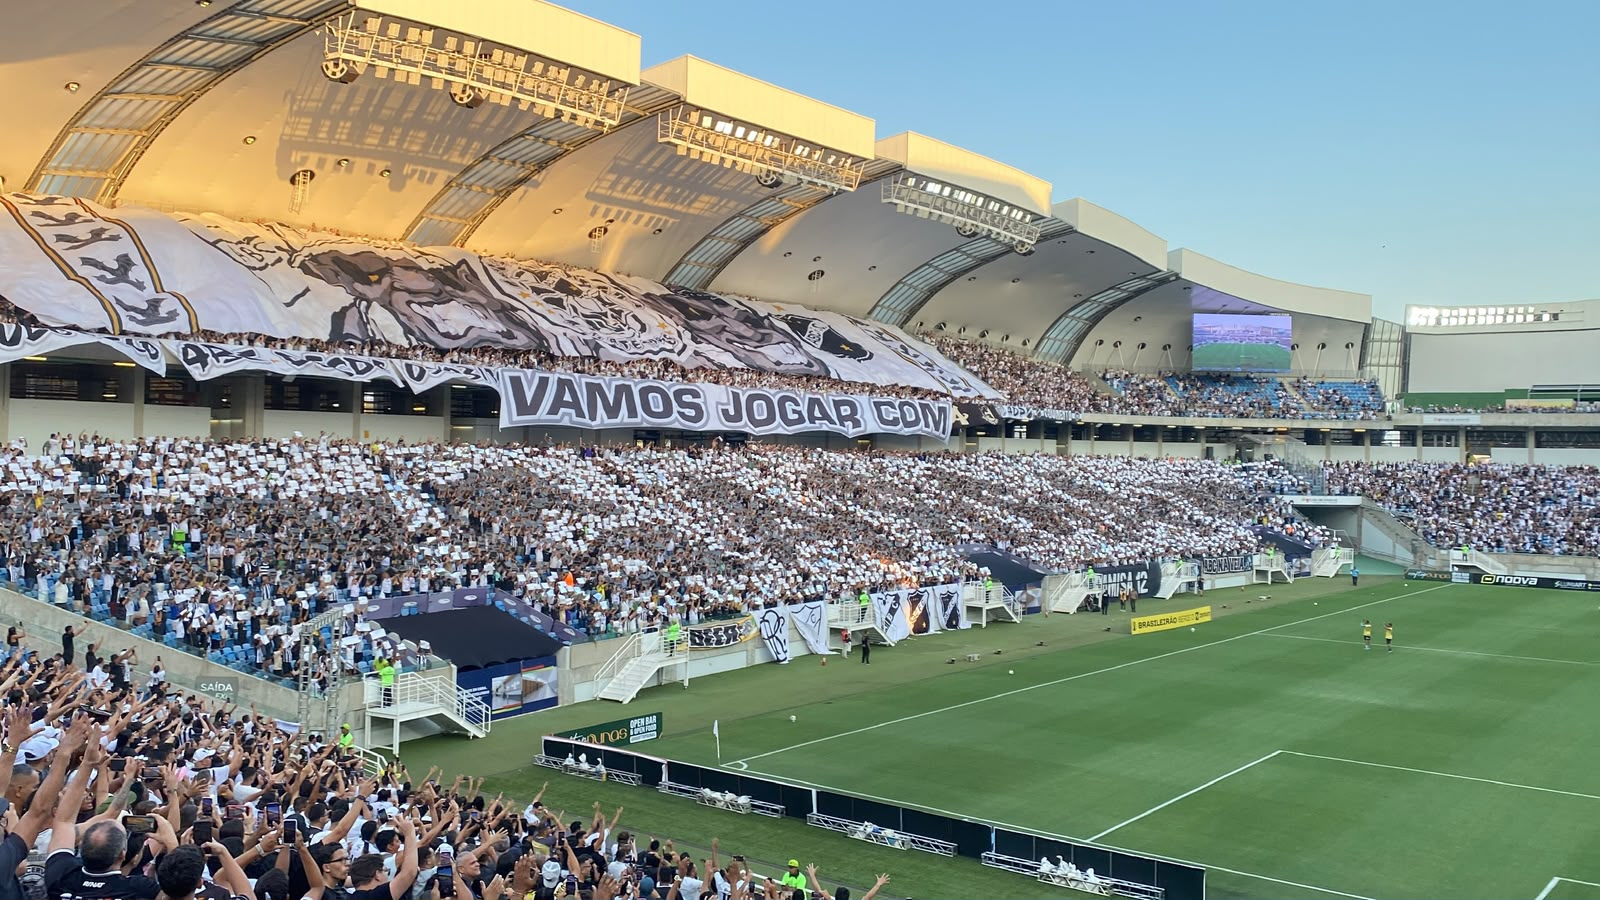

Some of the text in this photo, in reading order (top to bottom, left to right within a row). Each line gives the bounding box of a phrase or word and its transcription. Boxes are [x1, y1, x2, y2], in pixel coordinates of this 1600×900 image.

[508, 373, 704, 424] VAMOS
[721, 388, 864, 430] JOGAR
[873, 399, 949, 437] COM
[1103, 571, 1149, 597] AMISA 12
[1138, 616, 1177, 629] BRASILEIRÃO
[200, 681, 233, 692] SAÍDA
[630, 715, 657, 729] OPEN BAR
[634, 726, 645, 735] OPEN
[646, 723, 657, 732] FOOD
